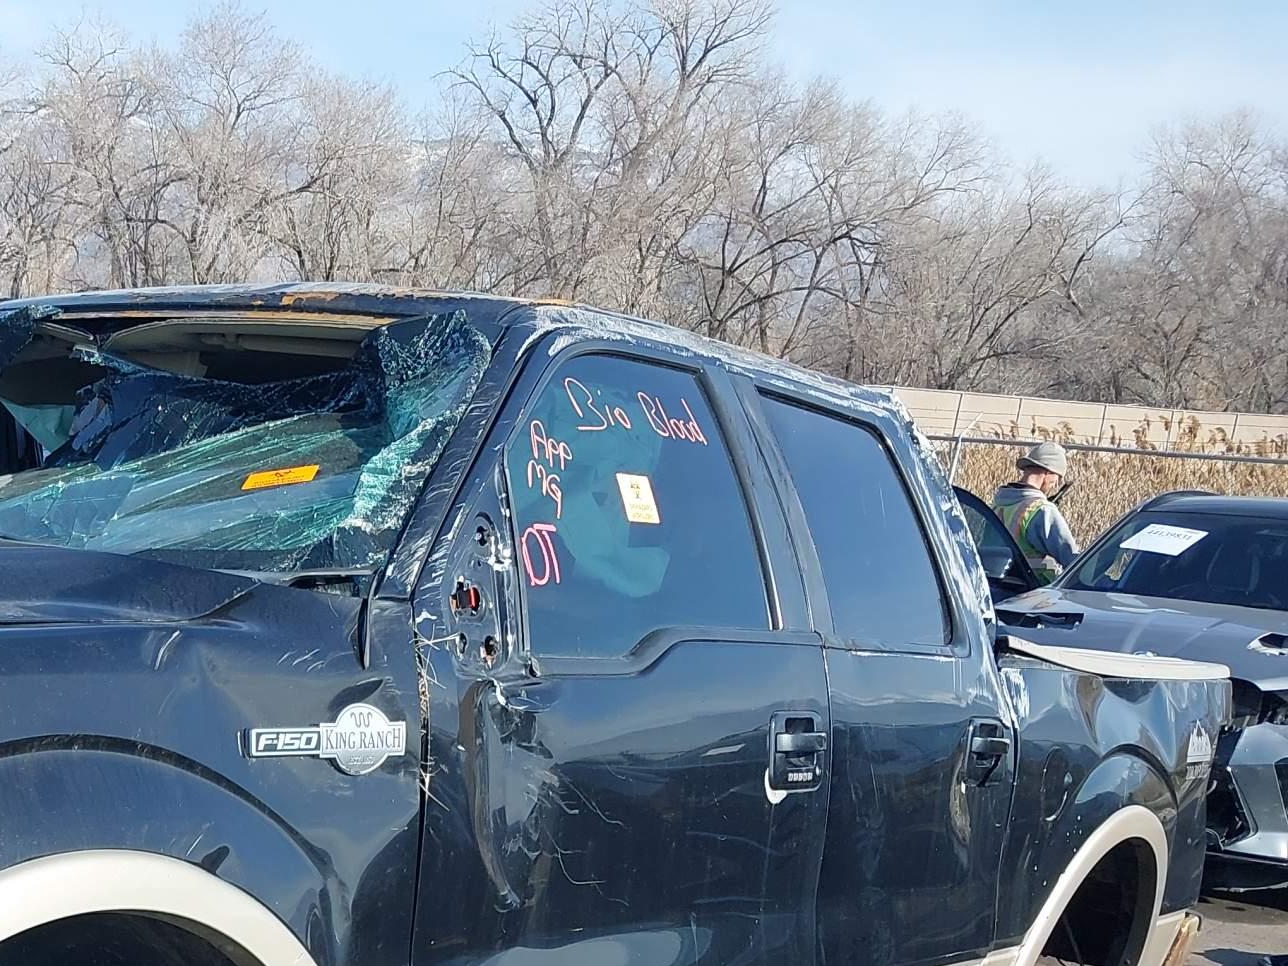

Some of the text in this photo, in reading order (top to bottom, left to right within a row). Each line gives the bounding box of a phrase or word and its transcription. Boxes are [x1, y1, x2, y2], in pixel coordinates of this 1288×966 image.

[565, 377, 708, 446] Bio Blood
[325, 727, 401, 751] KING RANCH
